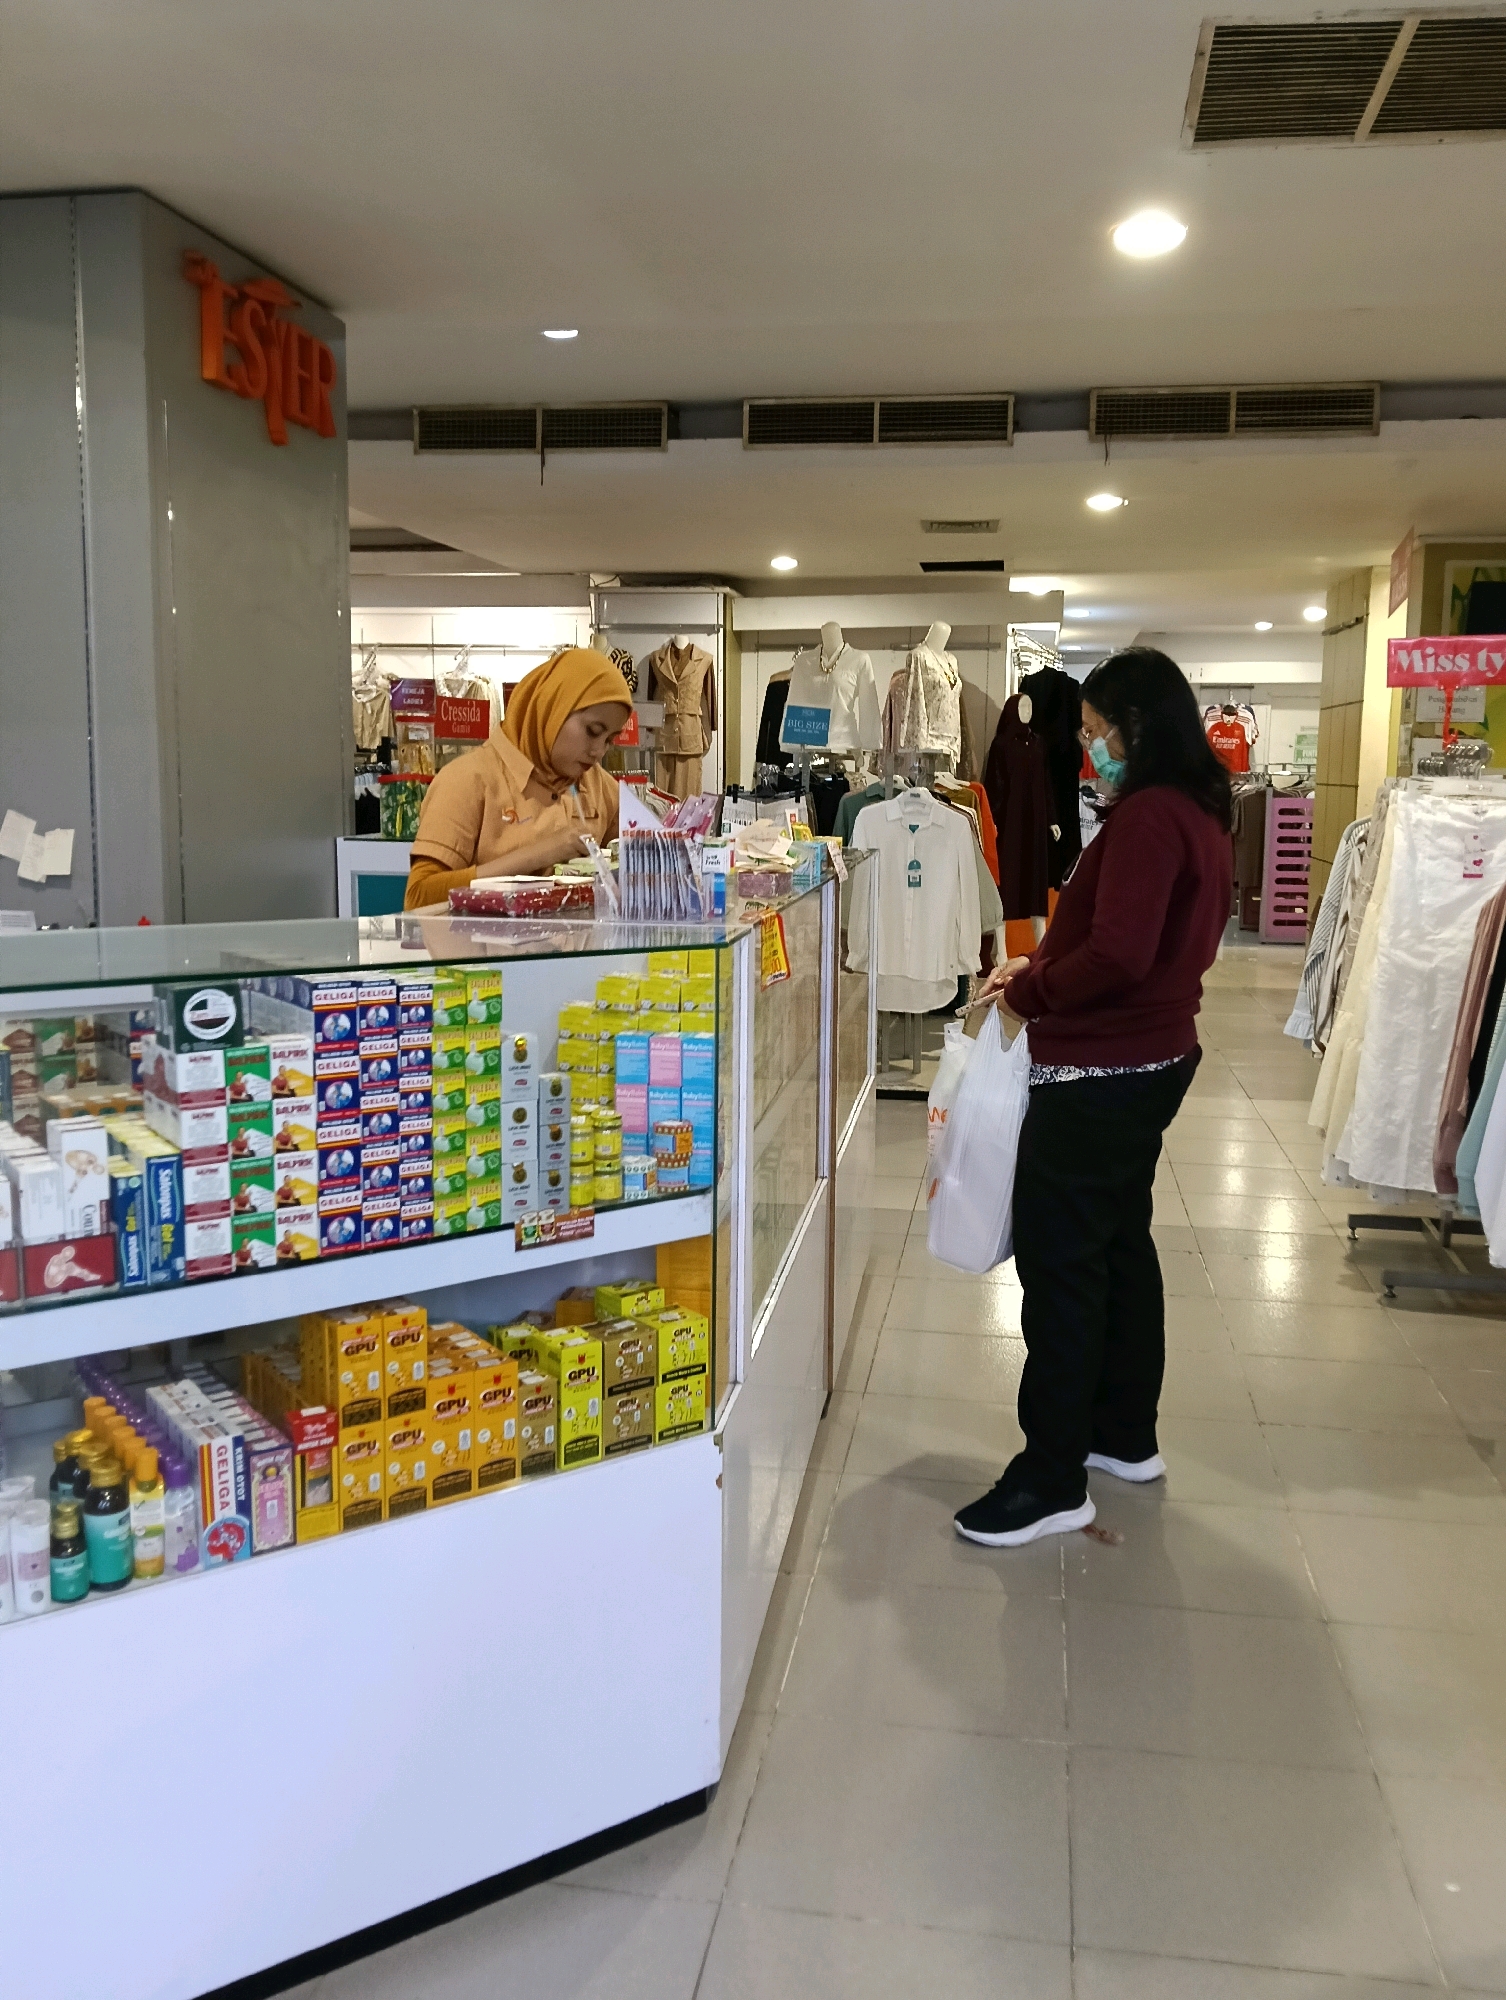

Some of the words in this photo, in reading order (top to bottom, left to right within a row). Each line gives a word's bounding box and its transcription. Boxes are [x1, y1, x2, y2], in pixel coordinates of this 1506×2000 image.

[441, 699, 481, 722] Cressida
[787, 719, 804, 728] BIG
[805, 720, 828, 731] SIZE
[1212, 736, 1240, 744] Emirates
[391, 1331, 421, 1347] GPU
[674, 1327, 692, 1338] GPU
[345, 1340, 377, 1356] GPU
[620, 1338, 640, 1350] GPU
[568, 1366, 596, 1381] GPU
[482, 1386, 512, 1403] GPU
[671, 1384, 689, 1395] GPU
[436, 1396, 467, 1413] GPU
[524, 1394, 552, 1410] GPU
[618, 1397, 638, 1407] GPU
[392, 1428, 422, 1445] GPU
[346, 1439, 377, 1456] GPU
[216, 1444, 231, 1511] GELIGA
